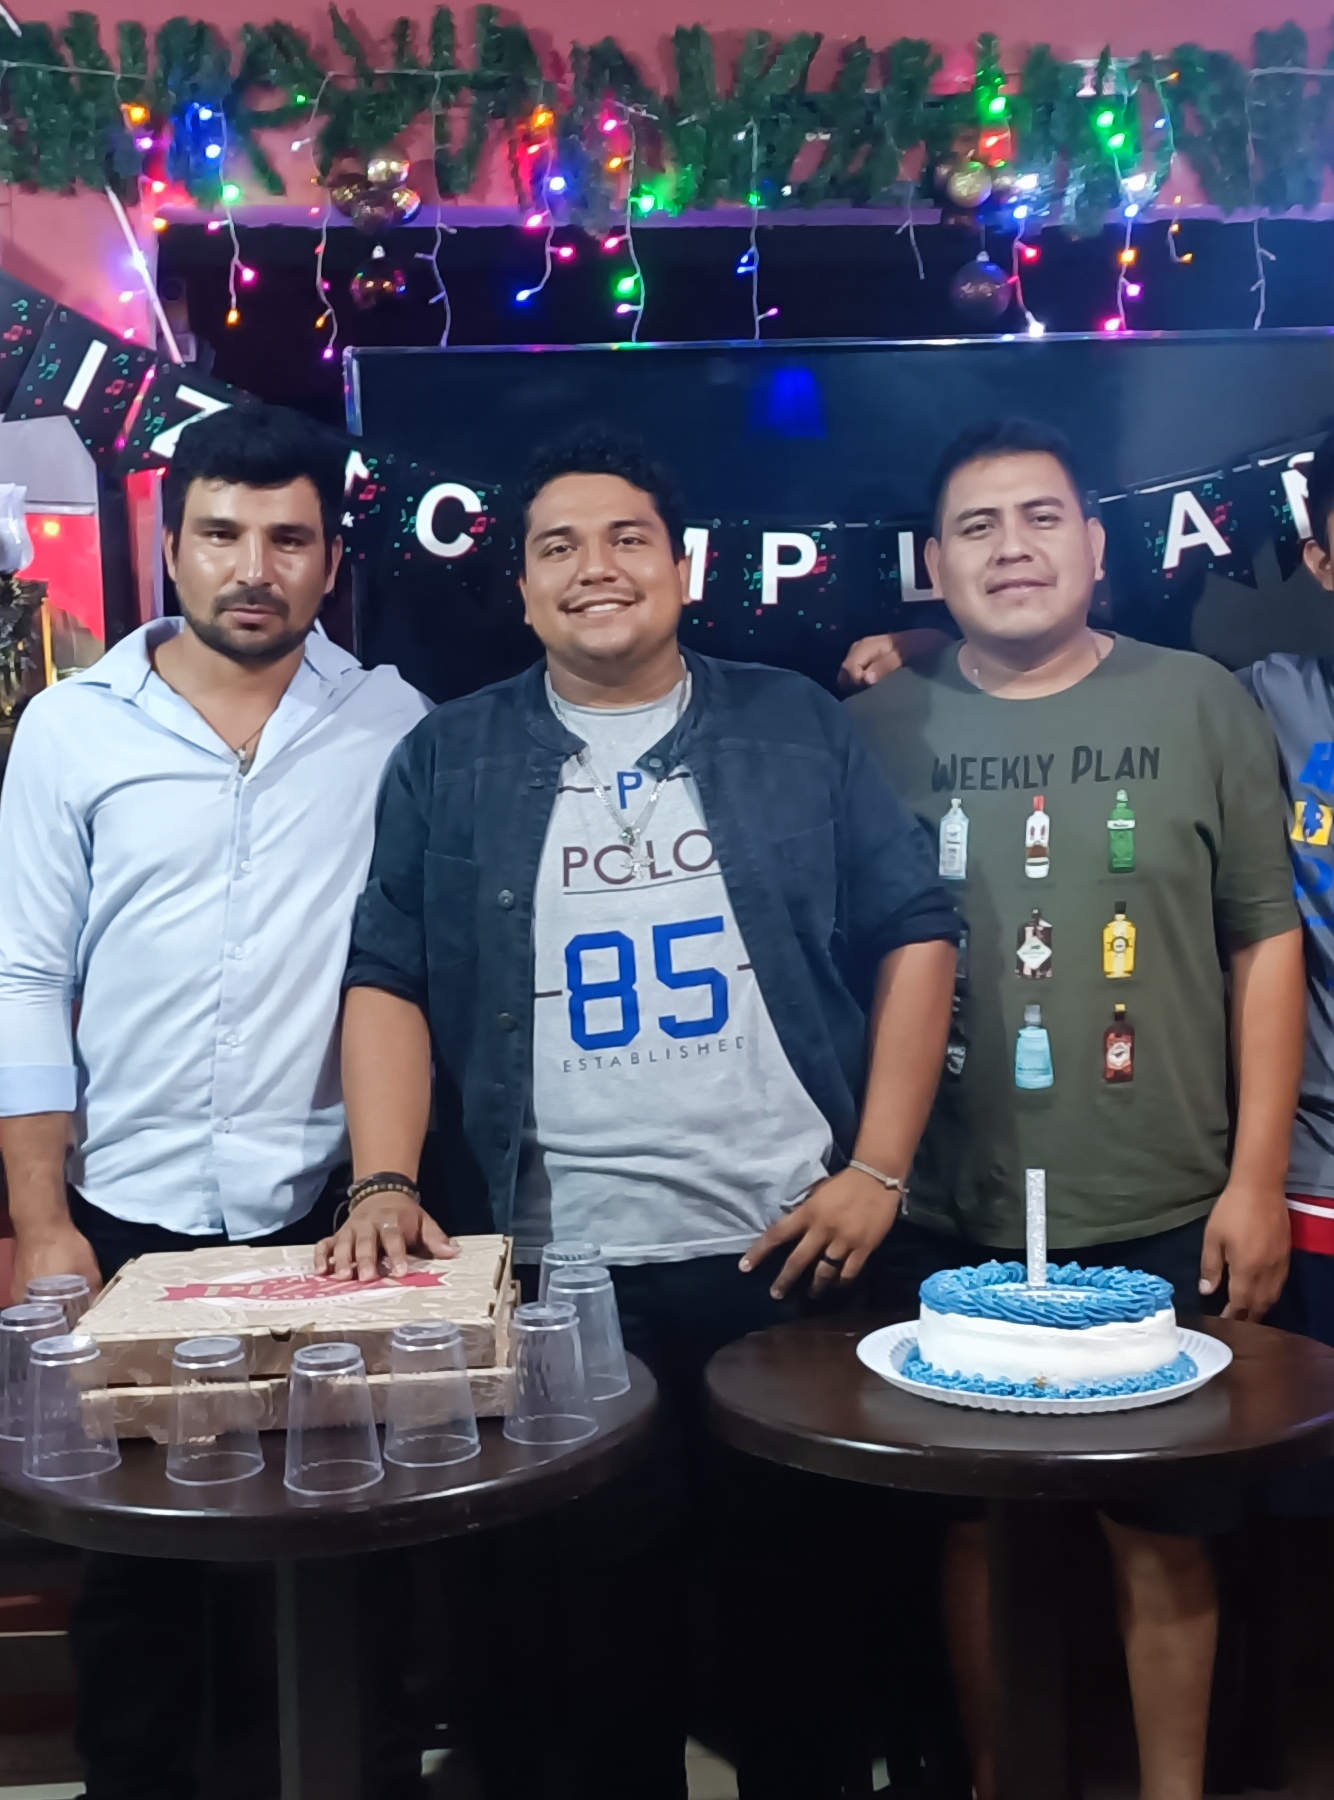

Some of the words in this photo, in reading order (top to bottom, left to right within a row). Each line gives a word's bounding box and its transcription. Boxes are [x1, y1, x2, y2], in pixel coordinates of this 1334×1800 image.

[616, 771, 643, 809] P
[931, 752, 1055, 793] WEEKLY
[1070, 745, 1160, 784] PLAN
[562, 829, 718, 888] POLO
[564, 915, 730, 1051] 85
